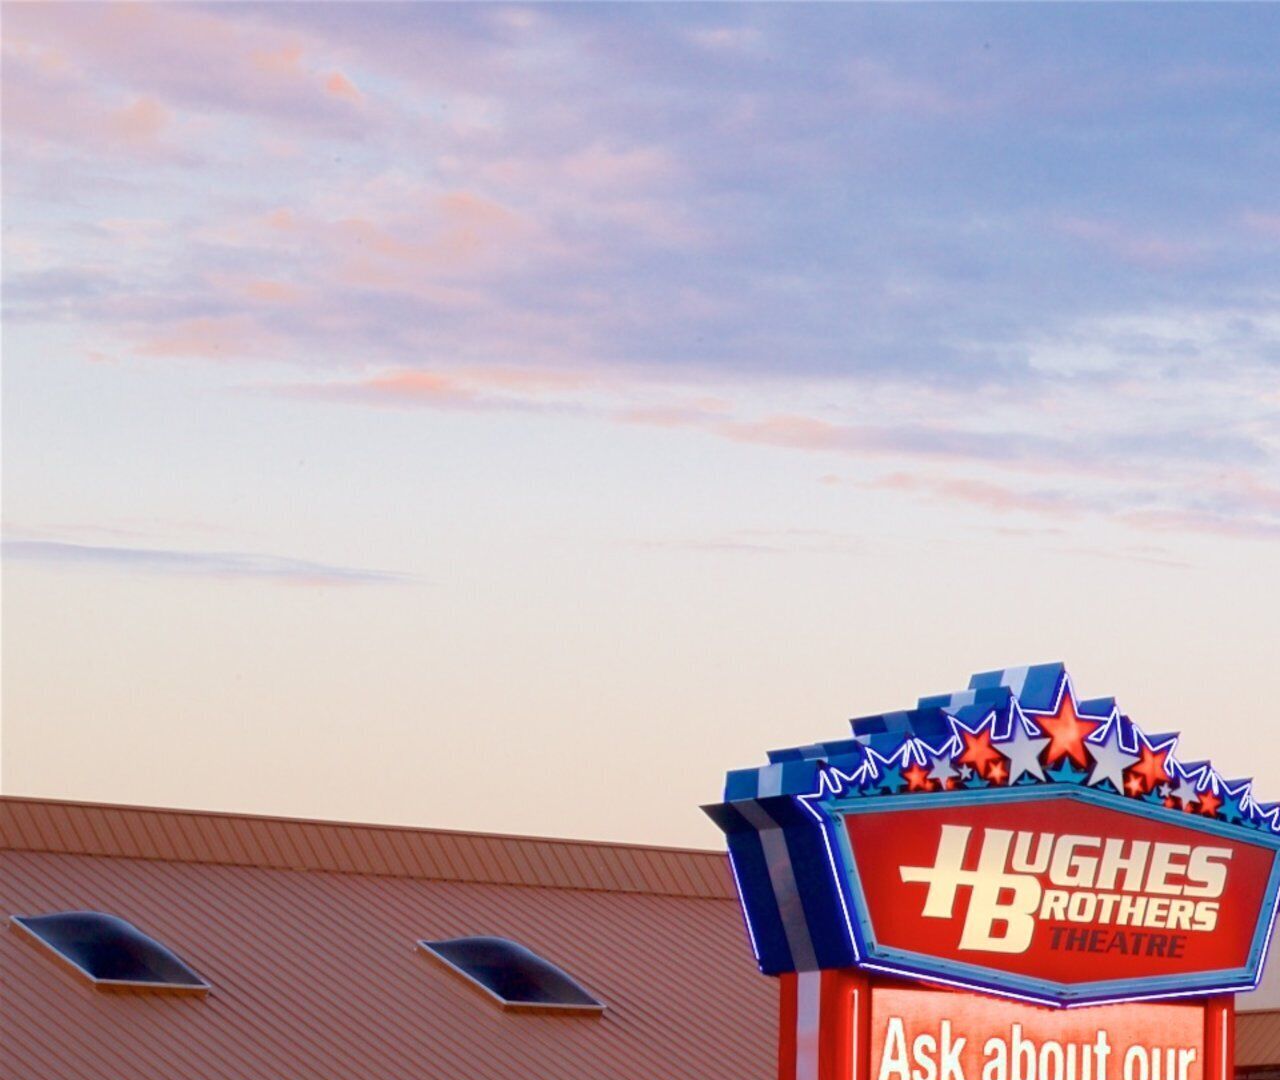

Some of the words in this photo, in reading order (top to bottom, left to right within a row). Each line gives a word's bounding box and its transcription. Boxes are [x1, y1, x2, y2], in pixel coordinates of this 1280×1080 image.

[899, 824, 1233, 918] HUGHES
[958, 874, 1219, 953] BROTHERS
[1049, 926, 1187, 958] THEATRE
